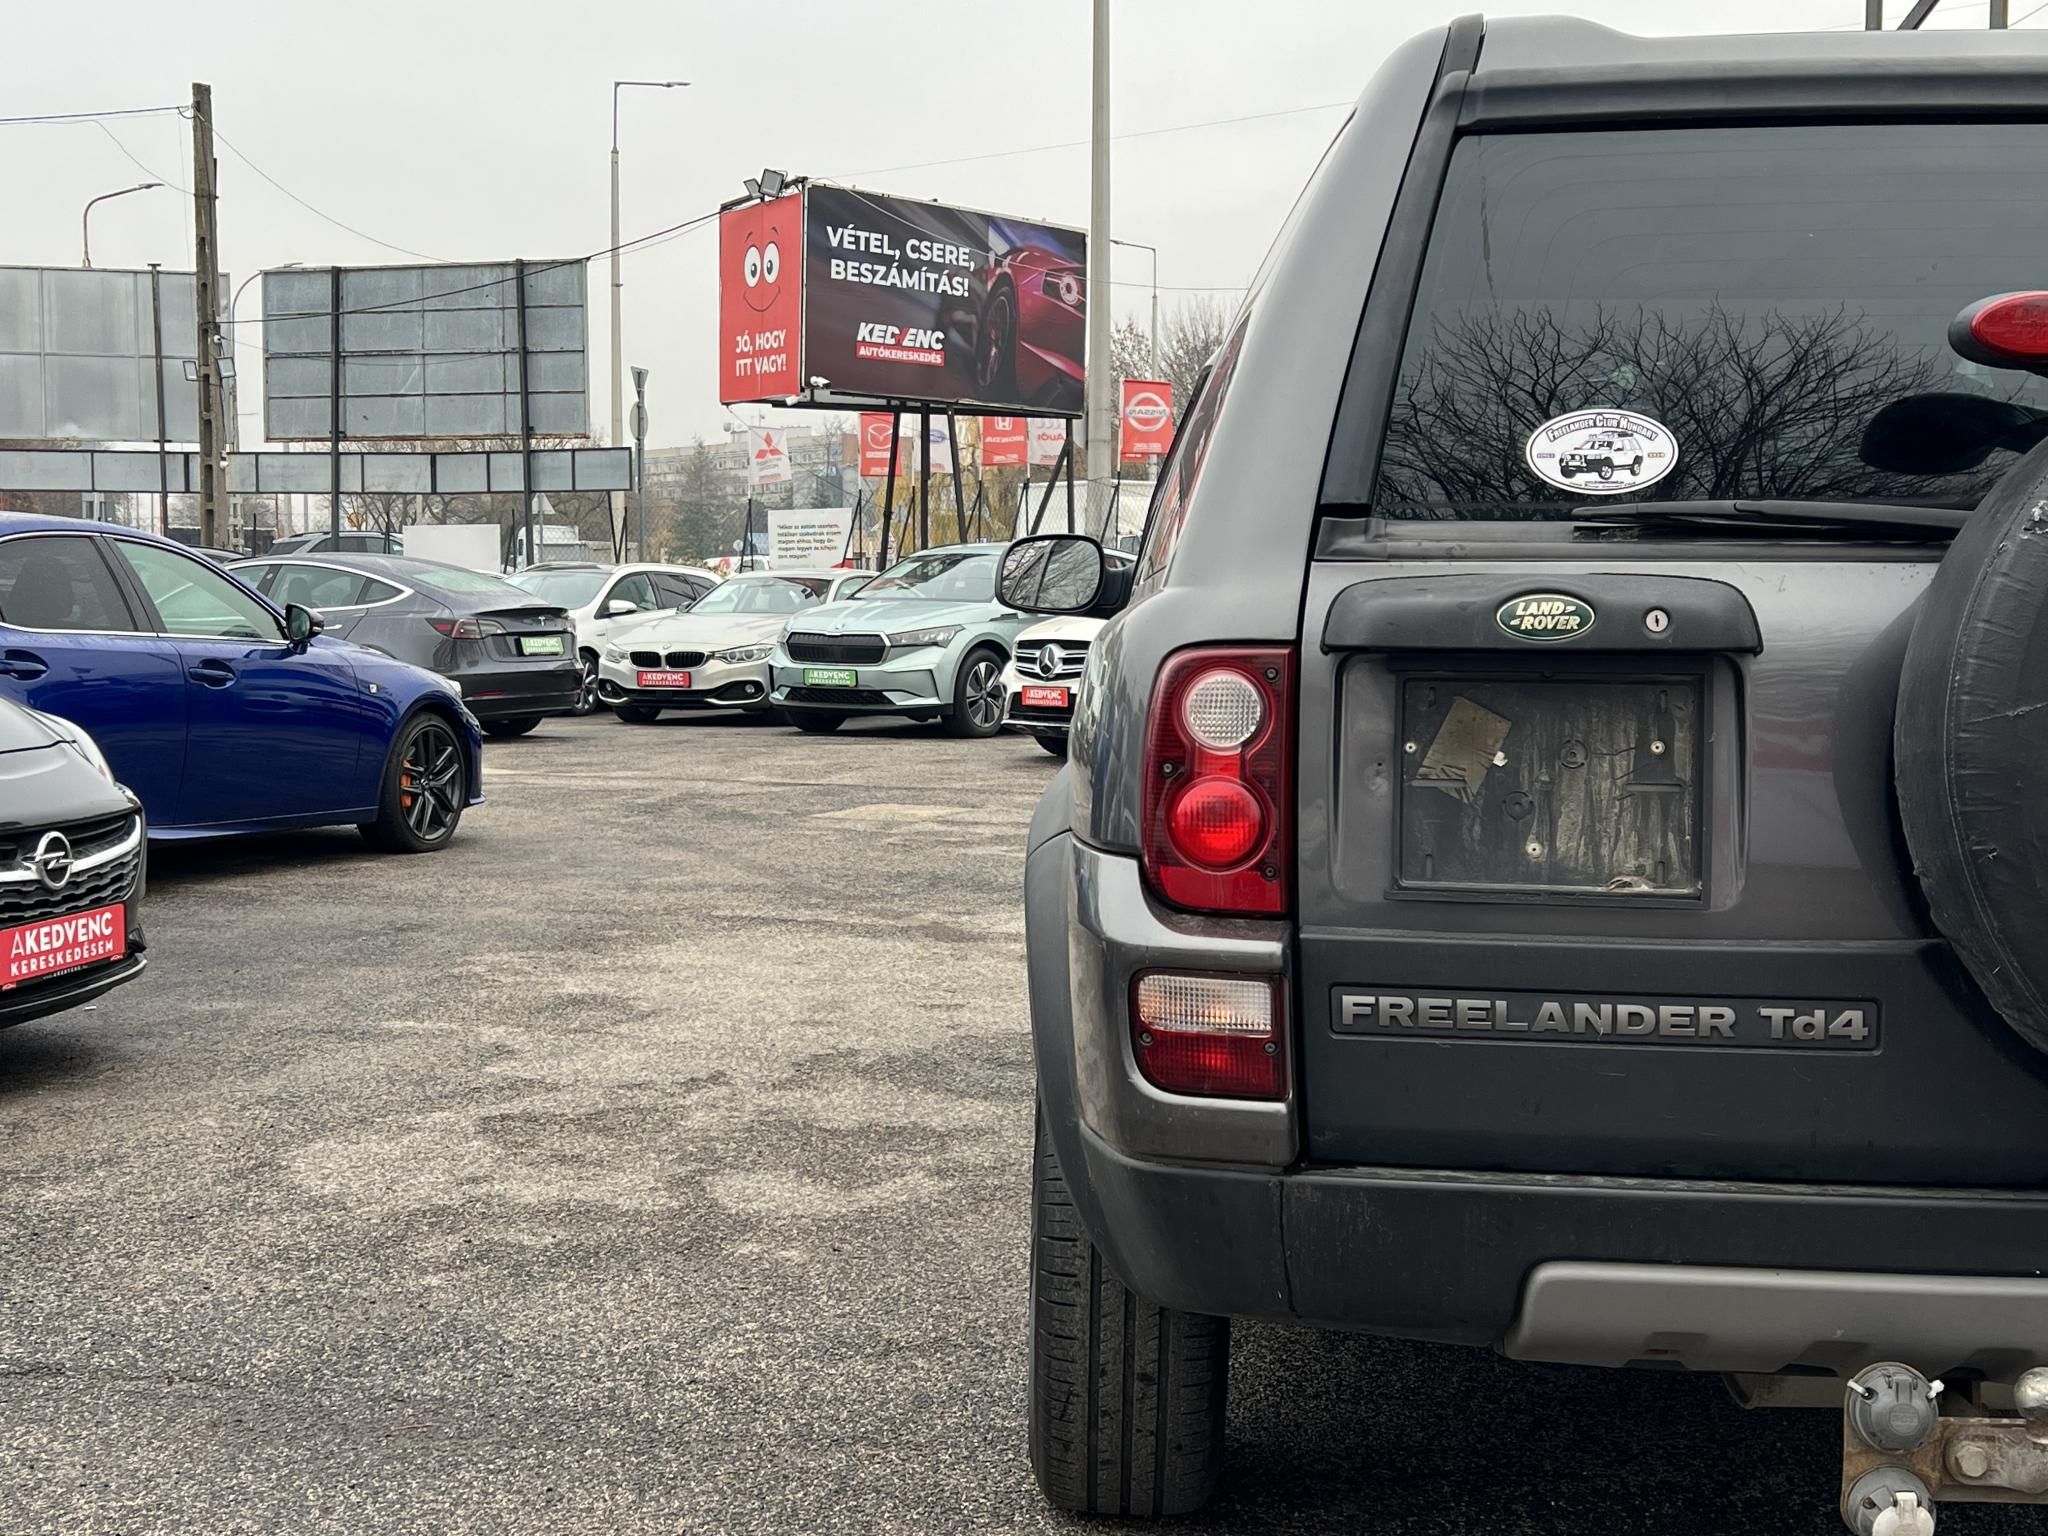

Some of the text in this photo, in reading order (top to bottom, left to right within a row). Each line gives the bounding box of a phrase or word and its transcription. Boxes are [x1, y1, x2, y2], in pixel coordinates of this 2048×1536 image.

[826, 224, 975, 272] VÉTEL, CSERE,
[830, 258, 970, 297] BESZÁMÍTÁS!
[735, 328, 787, 355] JÓ, HOGY
[735, 353, 787, 377] ITT VAGY!
[859, 345, 942, 364] AUTÓKERESKEDÉS
[1596, 415, 1618, 428] CLUB
[1516, 602, 1565, 616] LAND
[1520, 616, 1581, 630] ROVER
[642, 672, 684, 681] AKEDVENC
[808, 670, 850, 680] AKEDVENC
[10, 912, 113, 959] AKEDVENC
[10, 938, 114, 977] KERESKEDÉSEM
[1340, 993, 1869, 1042] FREELANDER Td4
